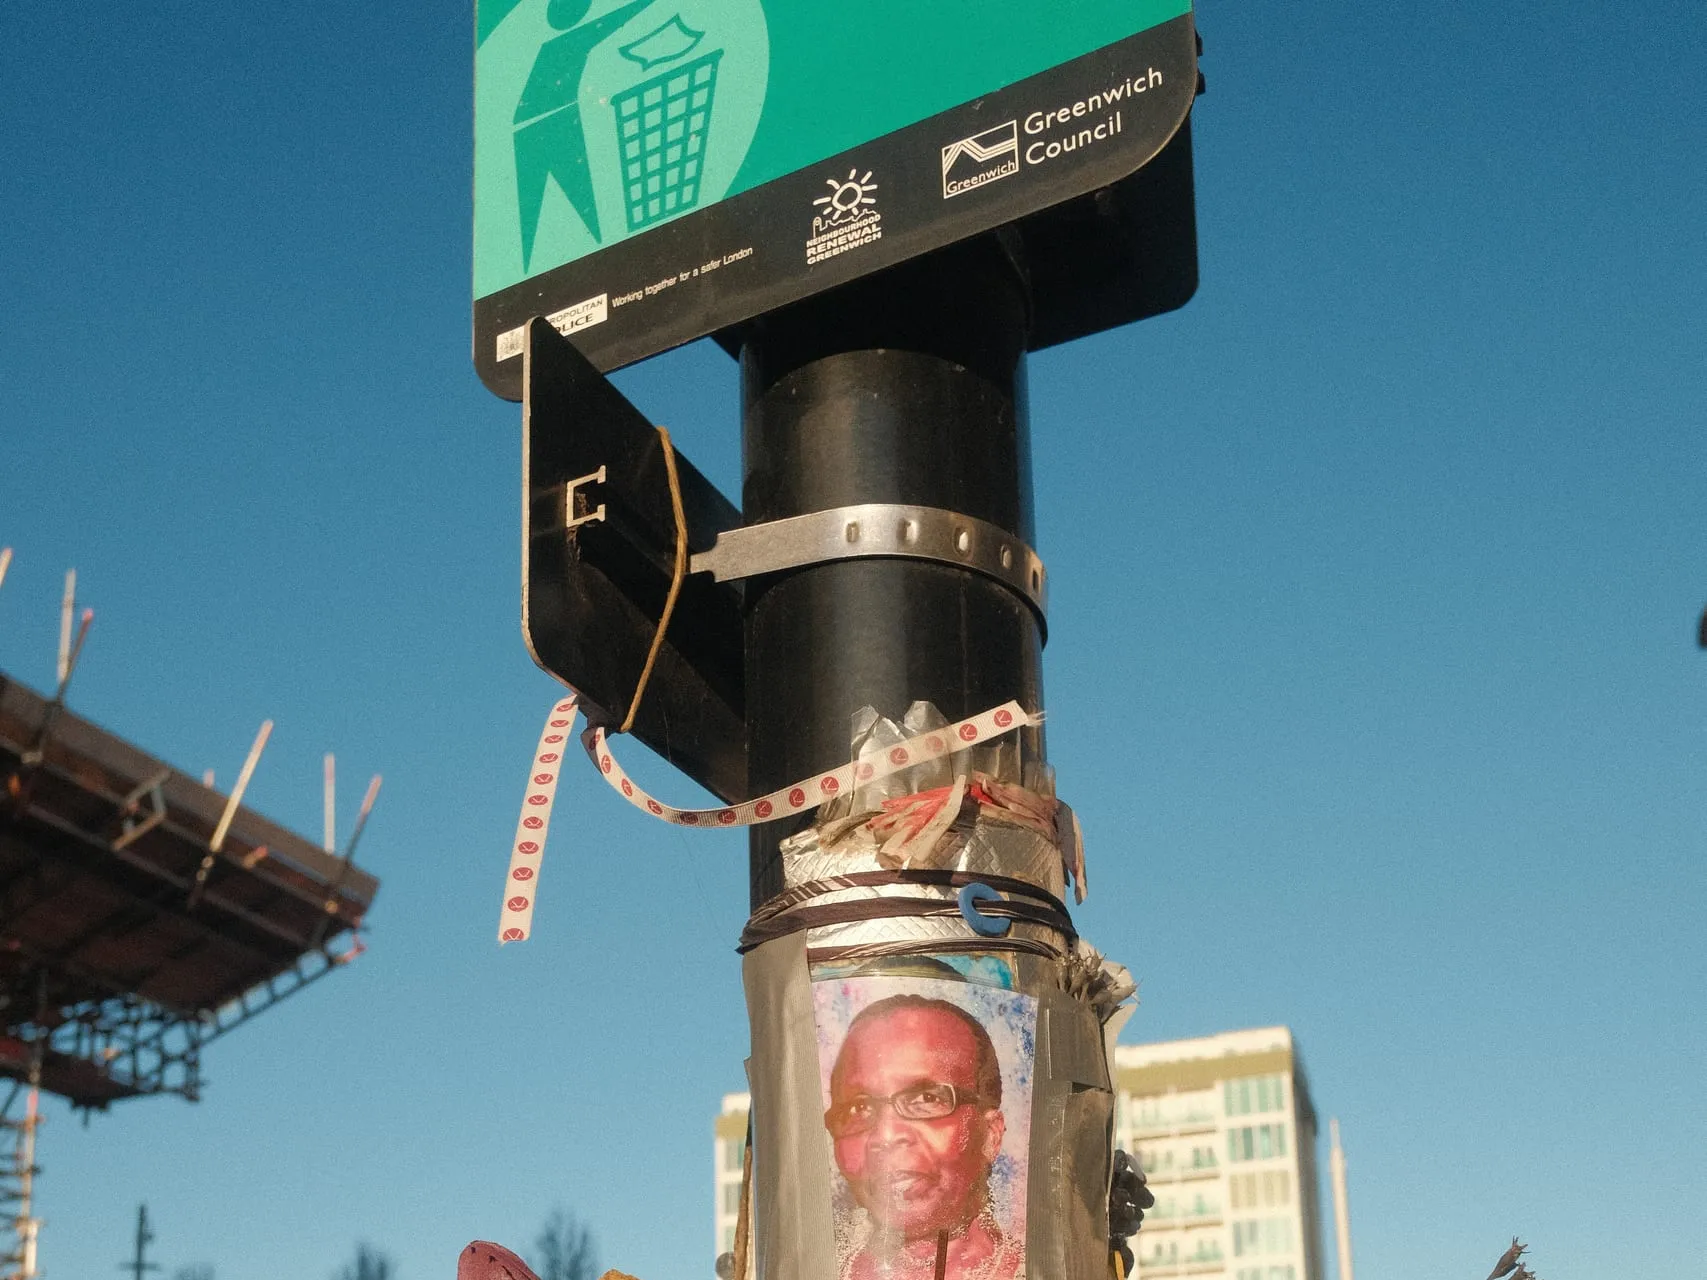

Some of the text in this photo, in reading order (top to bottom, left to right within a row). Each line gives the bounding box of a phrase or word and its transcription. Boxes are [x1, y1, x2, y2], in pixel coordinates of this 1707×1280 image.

[1024, 67, 1163, 135] Greenwich
[1025, 111, 1122, 165] Council
[946, 160, 1016, 195] Greenwich
[806, 214, 881, 248] NEIGHBOURHOOD
[806, 223, 881, 258] RENEWAL
[806, 231, 882, 265] GREENWICH
[612, 247, 753, 308] Working together for a safer London
[549, 299, 604, 324] ROPOLITAN
